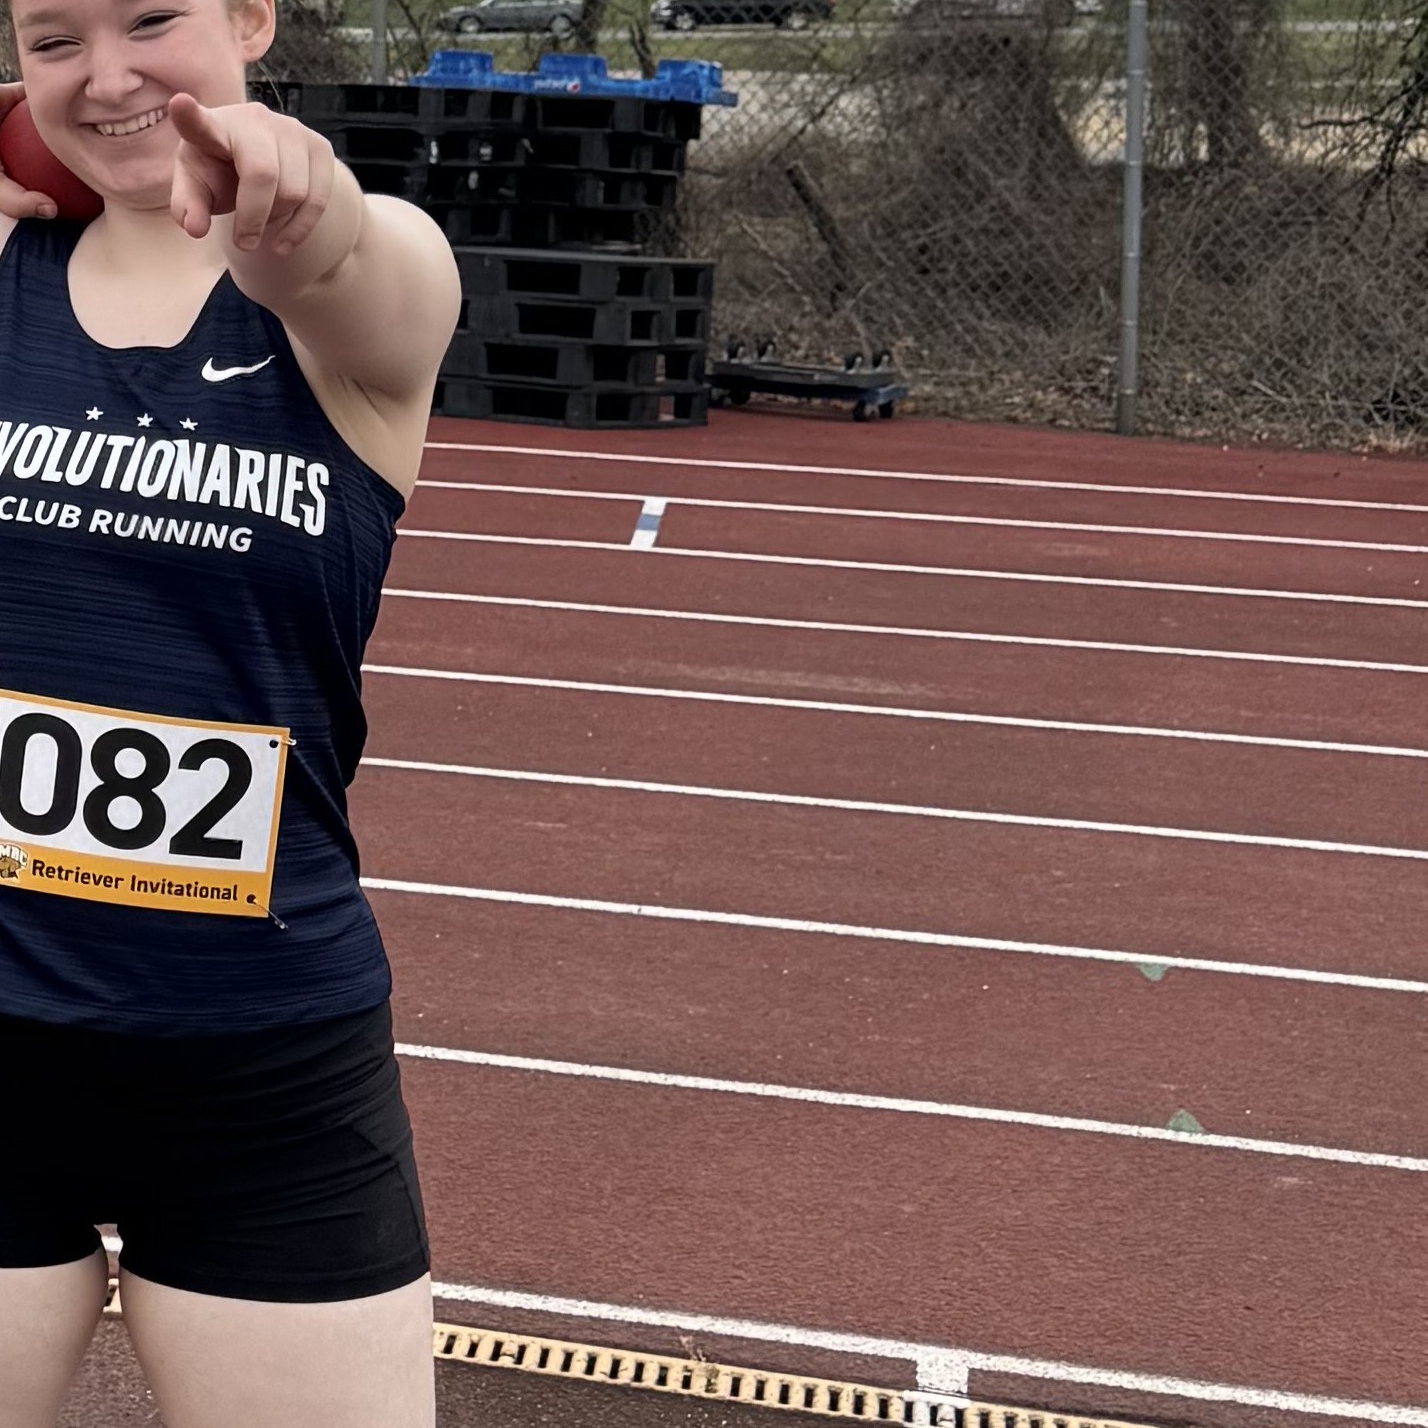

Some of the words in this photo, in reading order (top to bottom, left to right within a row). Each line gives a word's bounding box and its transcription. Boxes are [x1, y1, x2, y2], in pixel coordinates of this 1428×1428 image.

[88, 508, 253, 553] RUNNING
[31, 858, 125, 890] Retriever
[130, 874, 239, 902] Invitational
